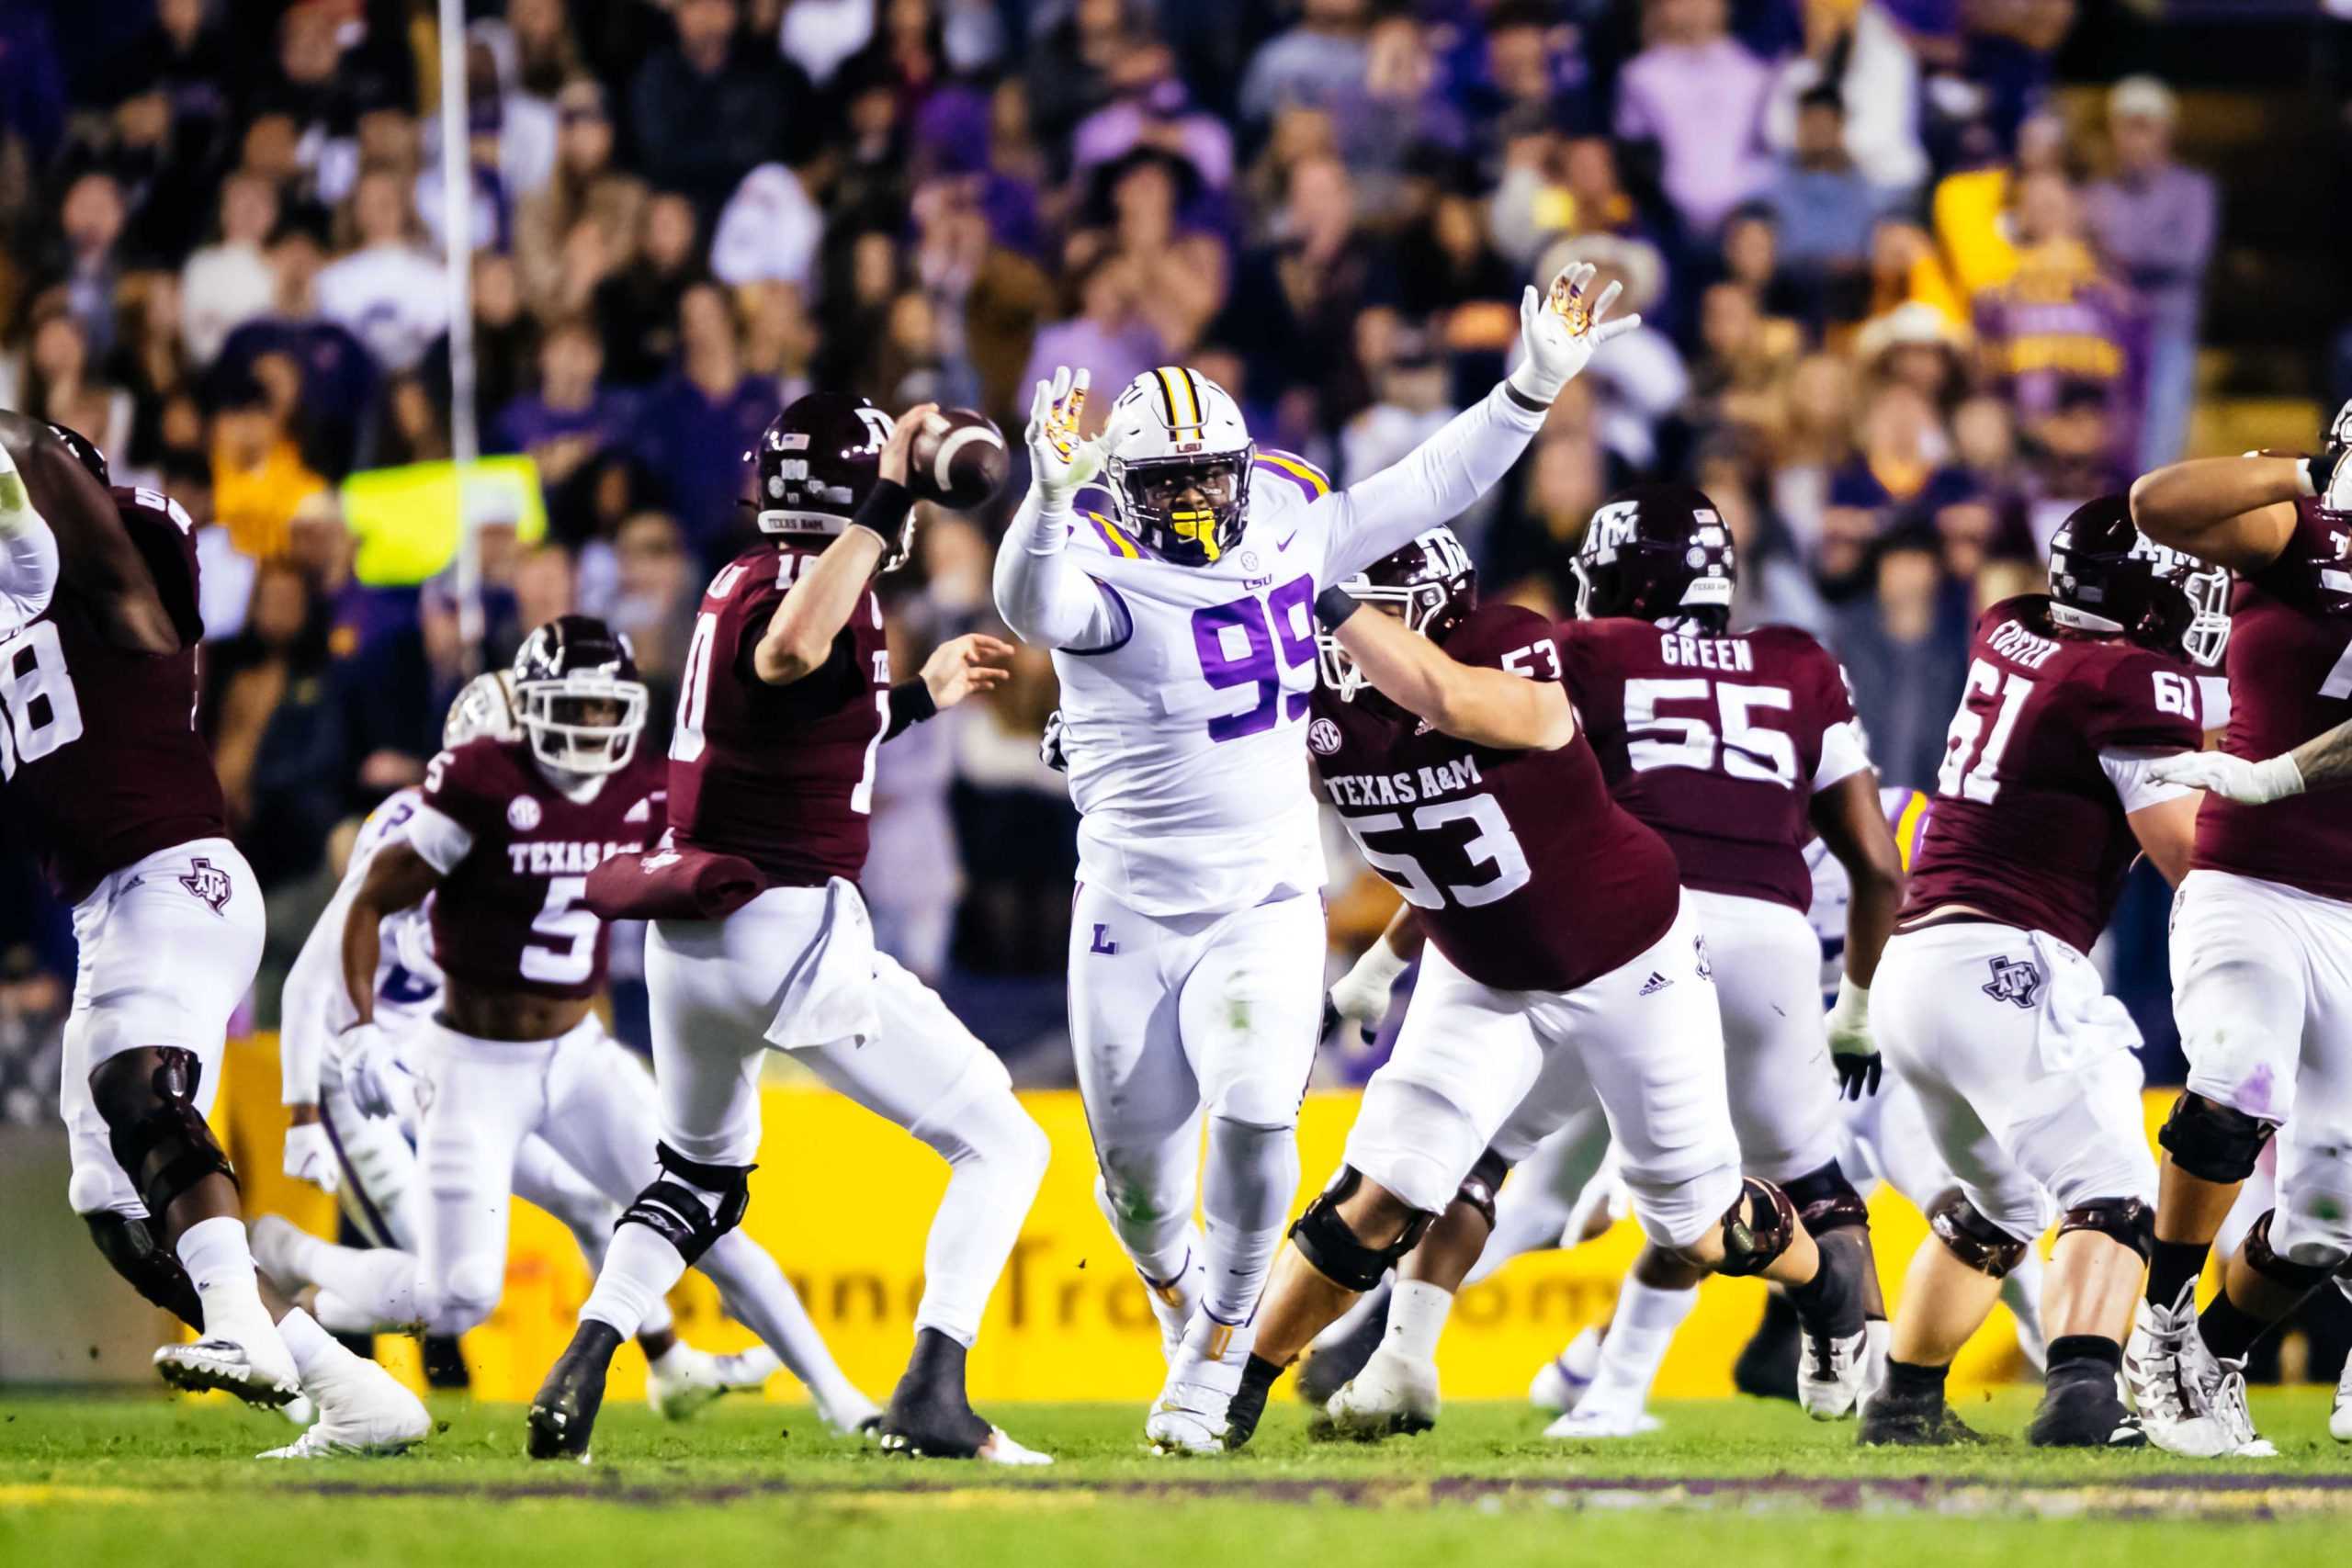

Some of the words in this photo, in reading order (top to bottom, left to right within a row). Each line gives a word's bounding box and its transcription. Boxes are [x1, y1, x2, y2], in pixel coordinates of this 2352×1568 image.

[1175, 442, 1203, 454] LSU
[1241, 572, 1272, 591] LSU
[1190, 572, 1319, 743] 99
[1500, 637, 1563, 680] 53
[1660, 633, 1754, 672] GREEN
[1985, 618, 2063, 670] FOSTER
[2151, 670, 2196, 721] 61
[1623, 677, 1798, 791] 55
[1937, 656, 2035, 806] 61
[424, 749, 456, 795] 5
[1322, 773, 1418, 807] TEXAS
[1417, 753, 1483, 799] A&M
[506, 840, 601, 874] TEXAS
[1338, 793, 1532, 910] 53
[518, 875, 602, 985] 5
[1089, 922, 1118, 955] L
